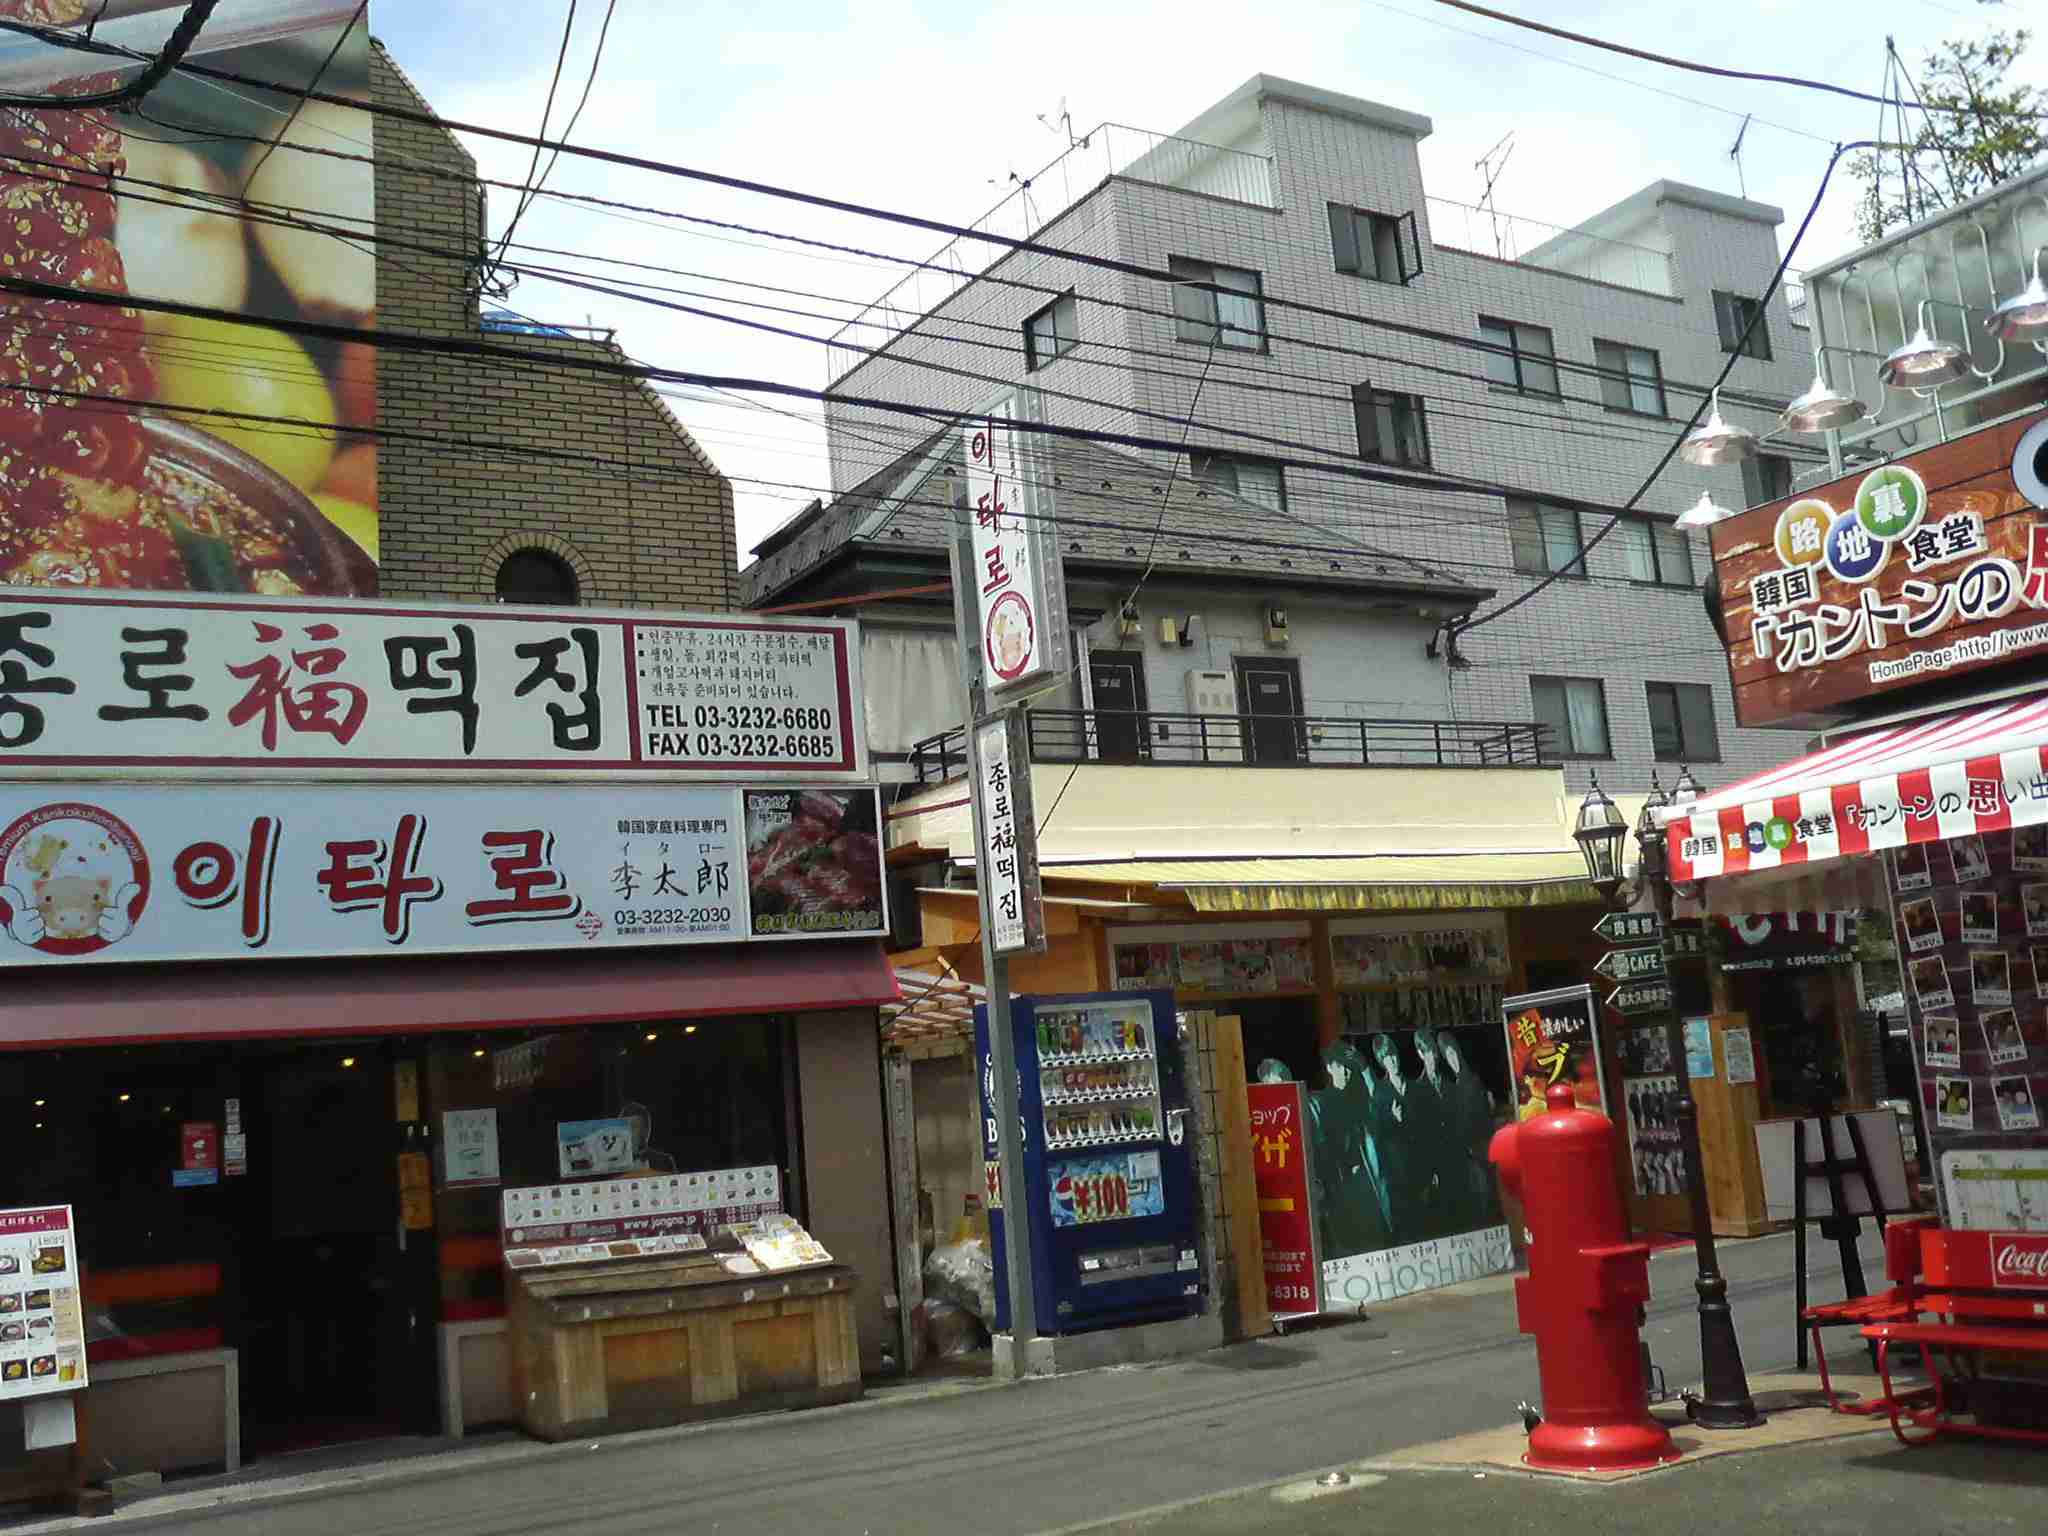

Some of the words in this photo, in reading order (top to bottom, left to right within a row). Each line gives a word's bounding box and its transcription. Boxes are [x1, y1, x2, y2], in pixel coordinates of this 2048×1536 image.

[1908, 516, 1977, 566] 食堂
[1754, 567, 1812, 611] 韓国
[646, 704, 688, 728] TEL
[695, 705, 831, 730] 03-3232-6680
[648, 733, 691, 756] FAX
[697, 734, 834, 757] 03-3232-6685
[617, 820, 728, 834] 韓国家庭料理専門
[1797, 812, 1834, 841] 食堂
[173, 814, 582, 948] 이타로
[608, 858, 730, 901] 李太郎
[614, 907, 730, 926] 03-3232-2030
[1517, 1016, 1537, 1048] 昔
